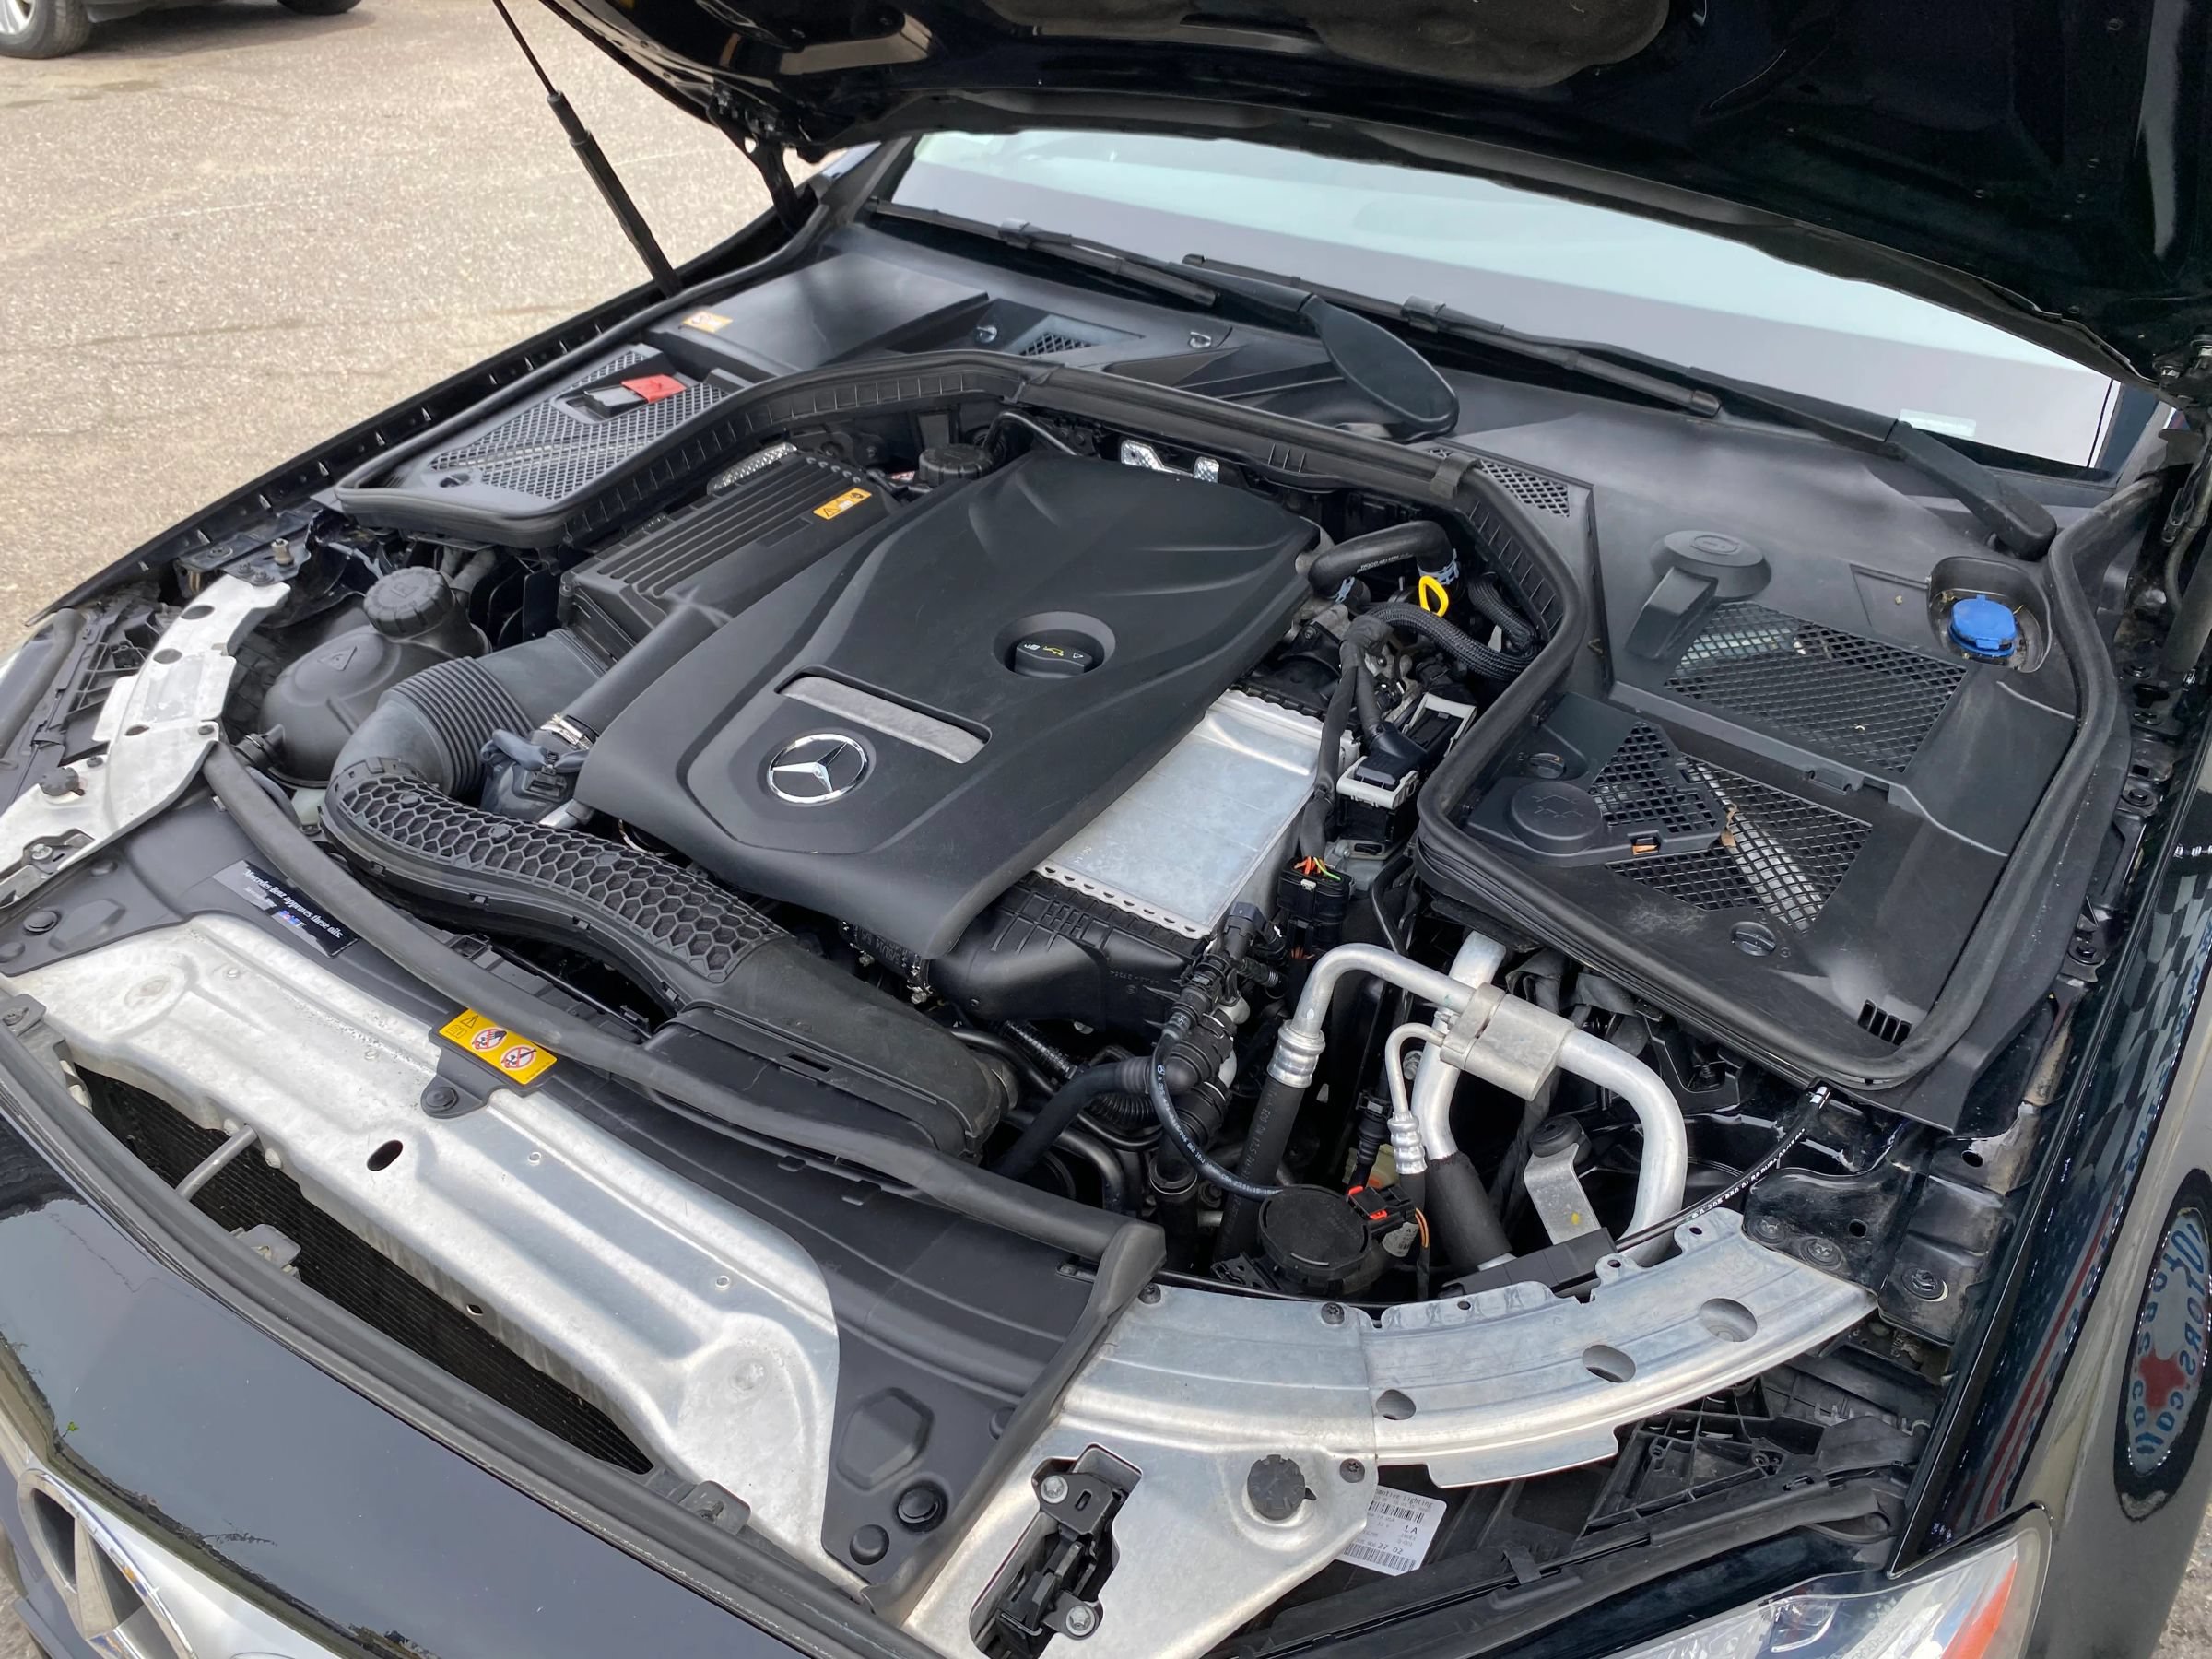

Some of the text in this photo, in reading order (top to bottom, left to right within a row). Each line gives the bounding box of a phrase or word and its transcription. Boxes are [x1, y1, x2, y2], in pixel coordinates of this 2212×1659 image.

[243, 869, 287, 900] Mercedes-Benz
[283, 896, 312, 919] approves
[311, 913, 329, 929] these
[1405, 1524, 1418, 1535] LA
[1377, 1542, 1389, 1551] 27
[1393, 1547, 1404, 1555] 02
